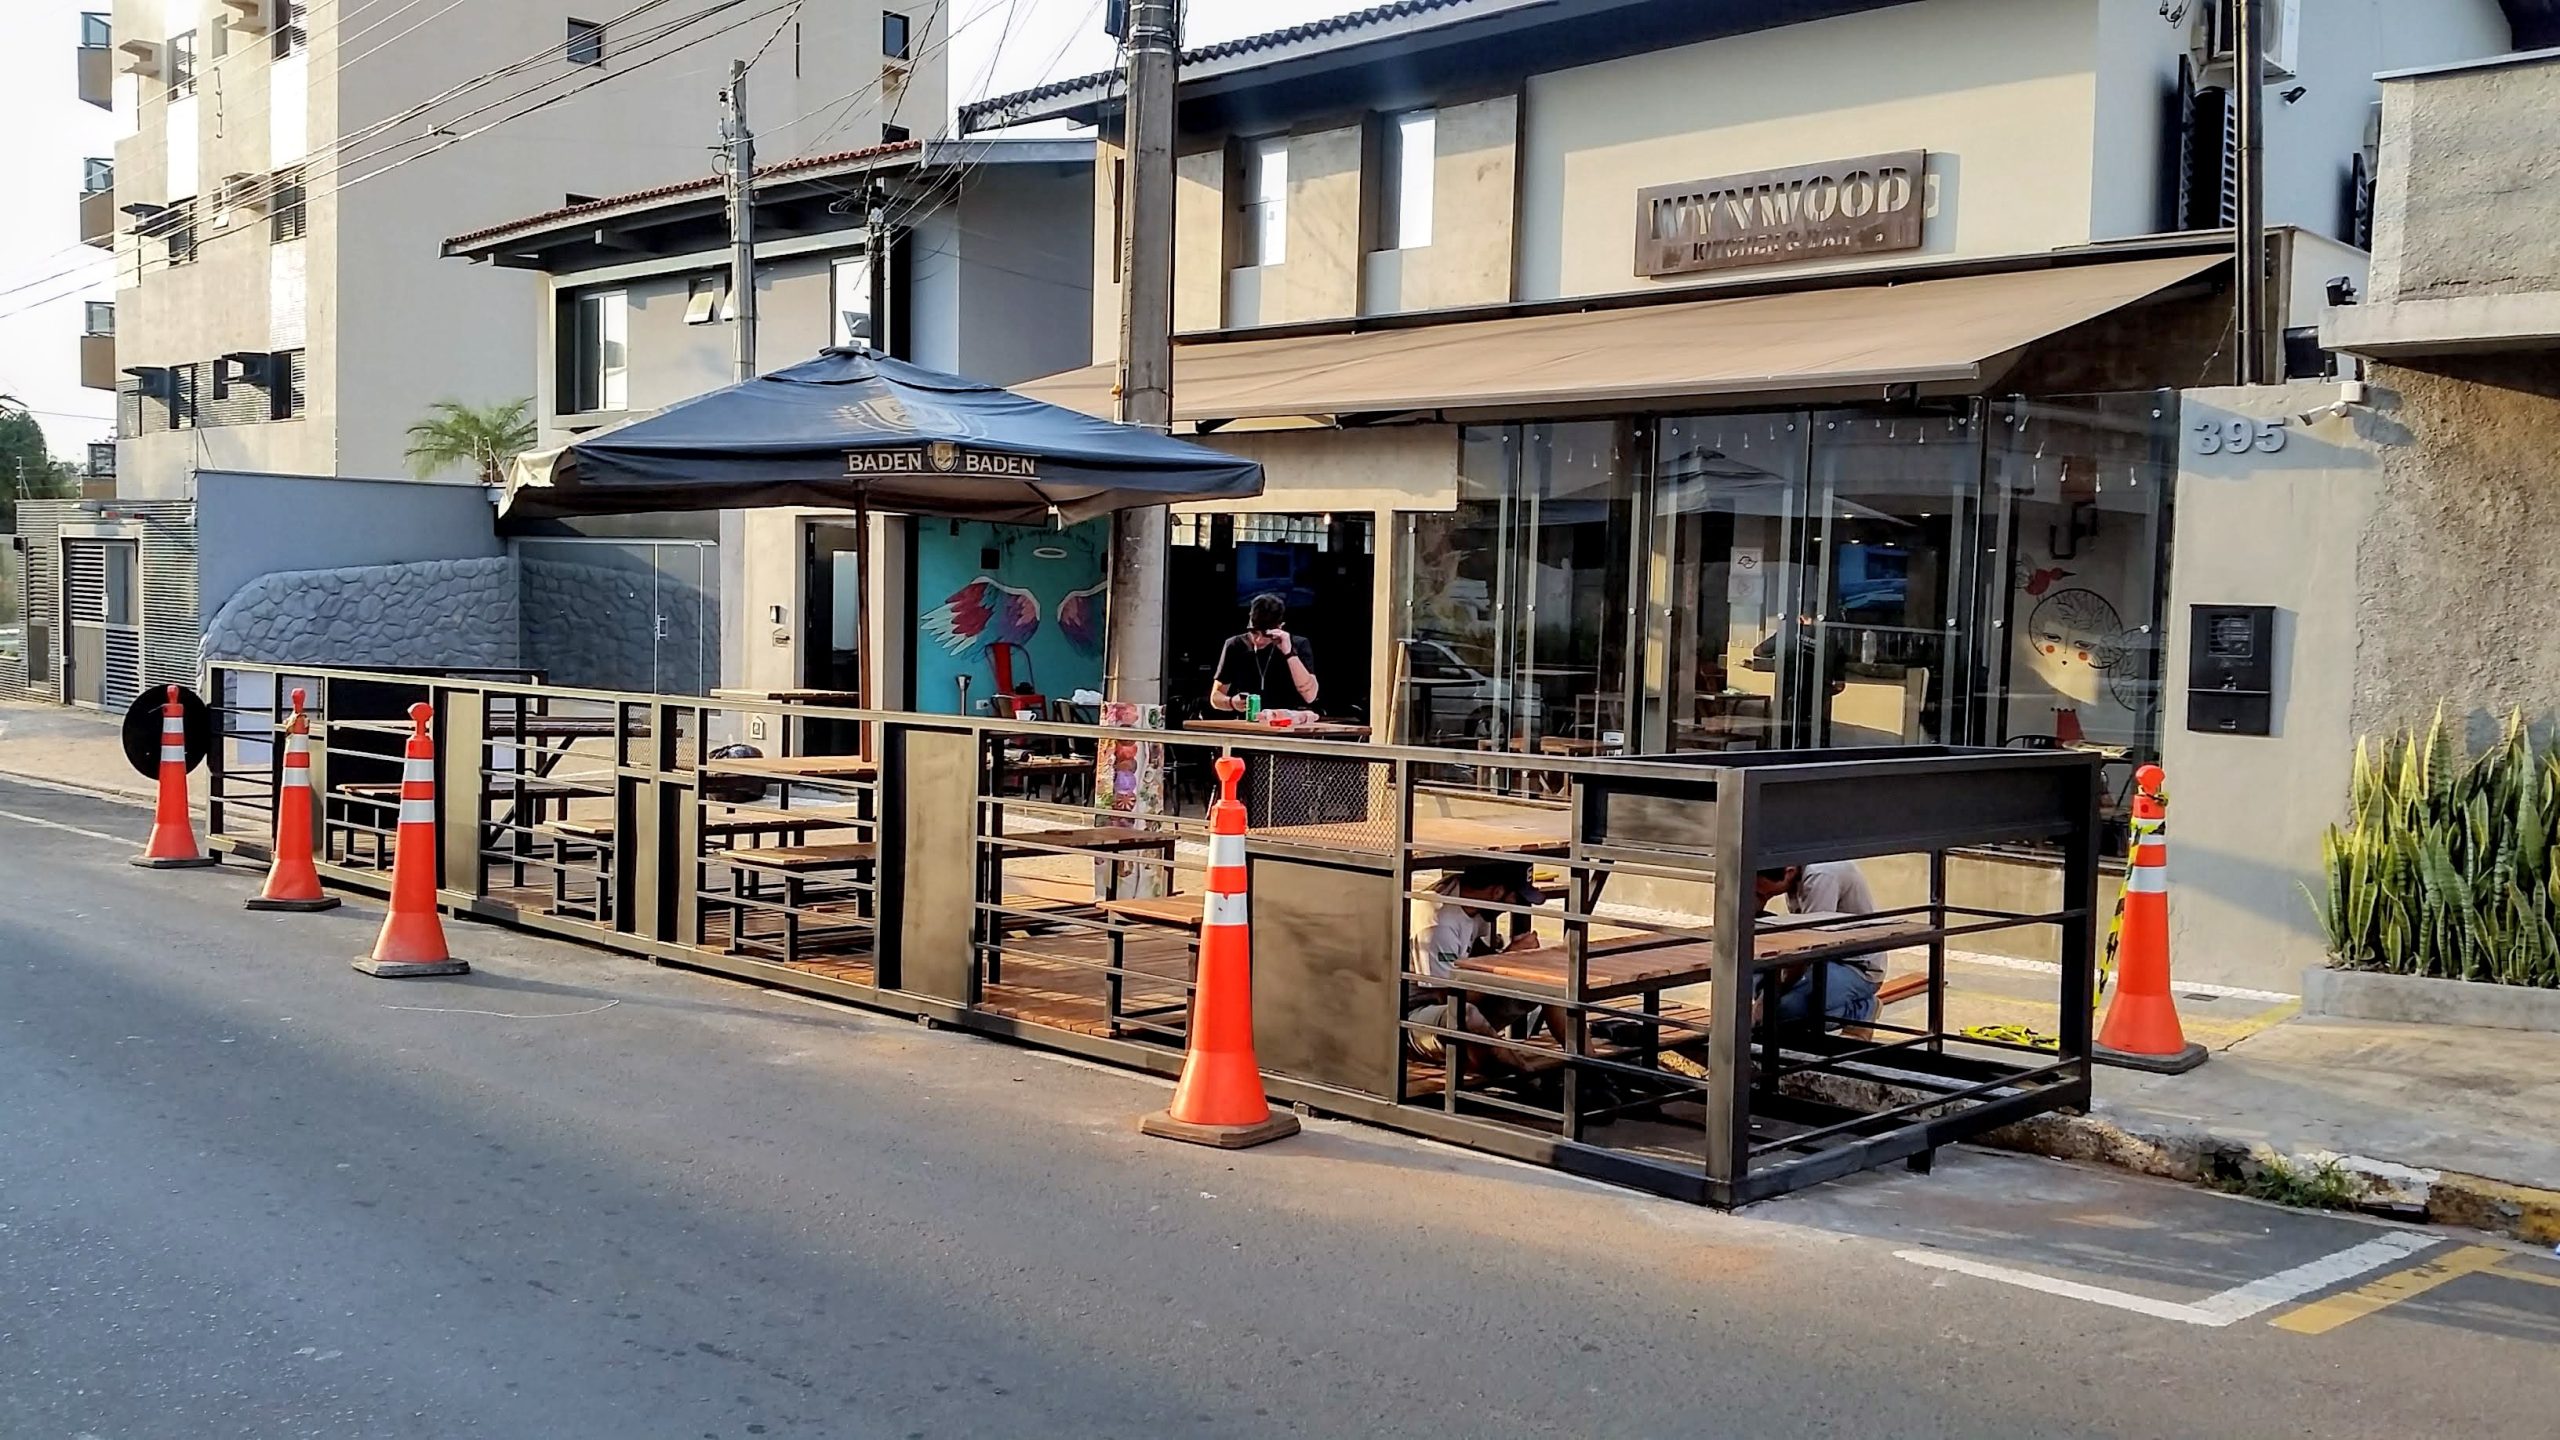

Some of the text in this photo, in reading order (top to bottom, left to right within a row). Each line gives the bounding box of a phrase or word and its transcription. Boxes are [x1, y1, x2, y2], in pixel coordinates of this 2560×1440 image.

[1649, 167, 1912, 240] WYNWOOD
[2193, 417, 2287, 455] 395
[849, 453, 1035, 474] BADEN BADEN
